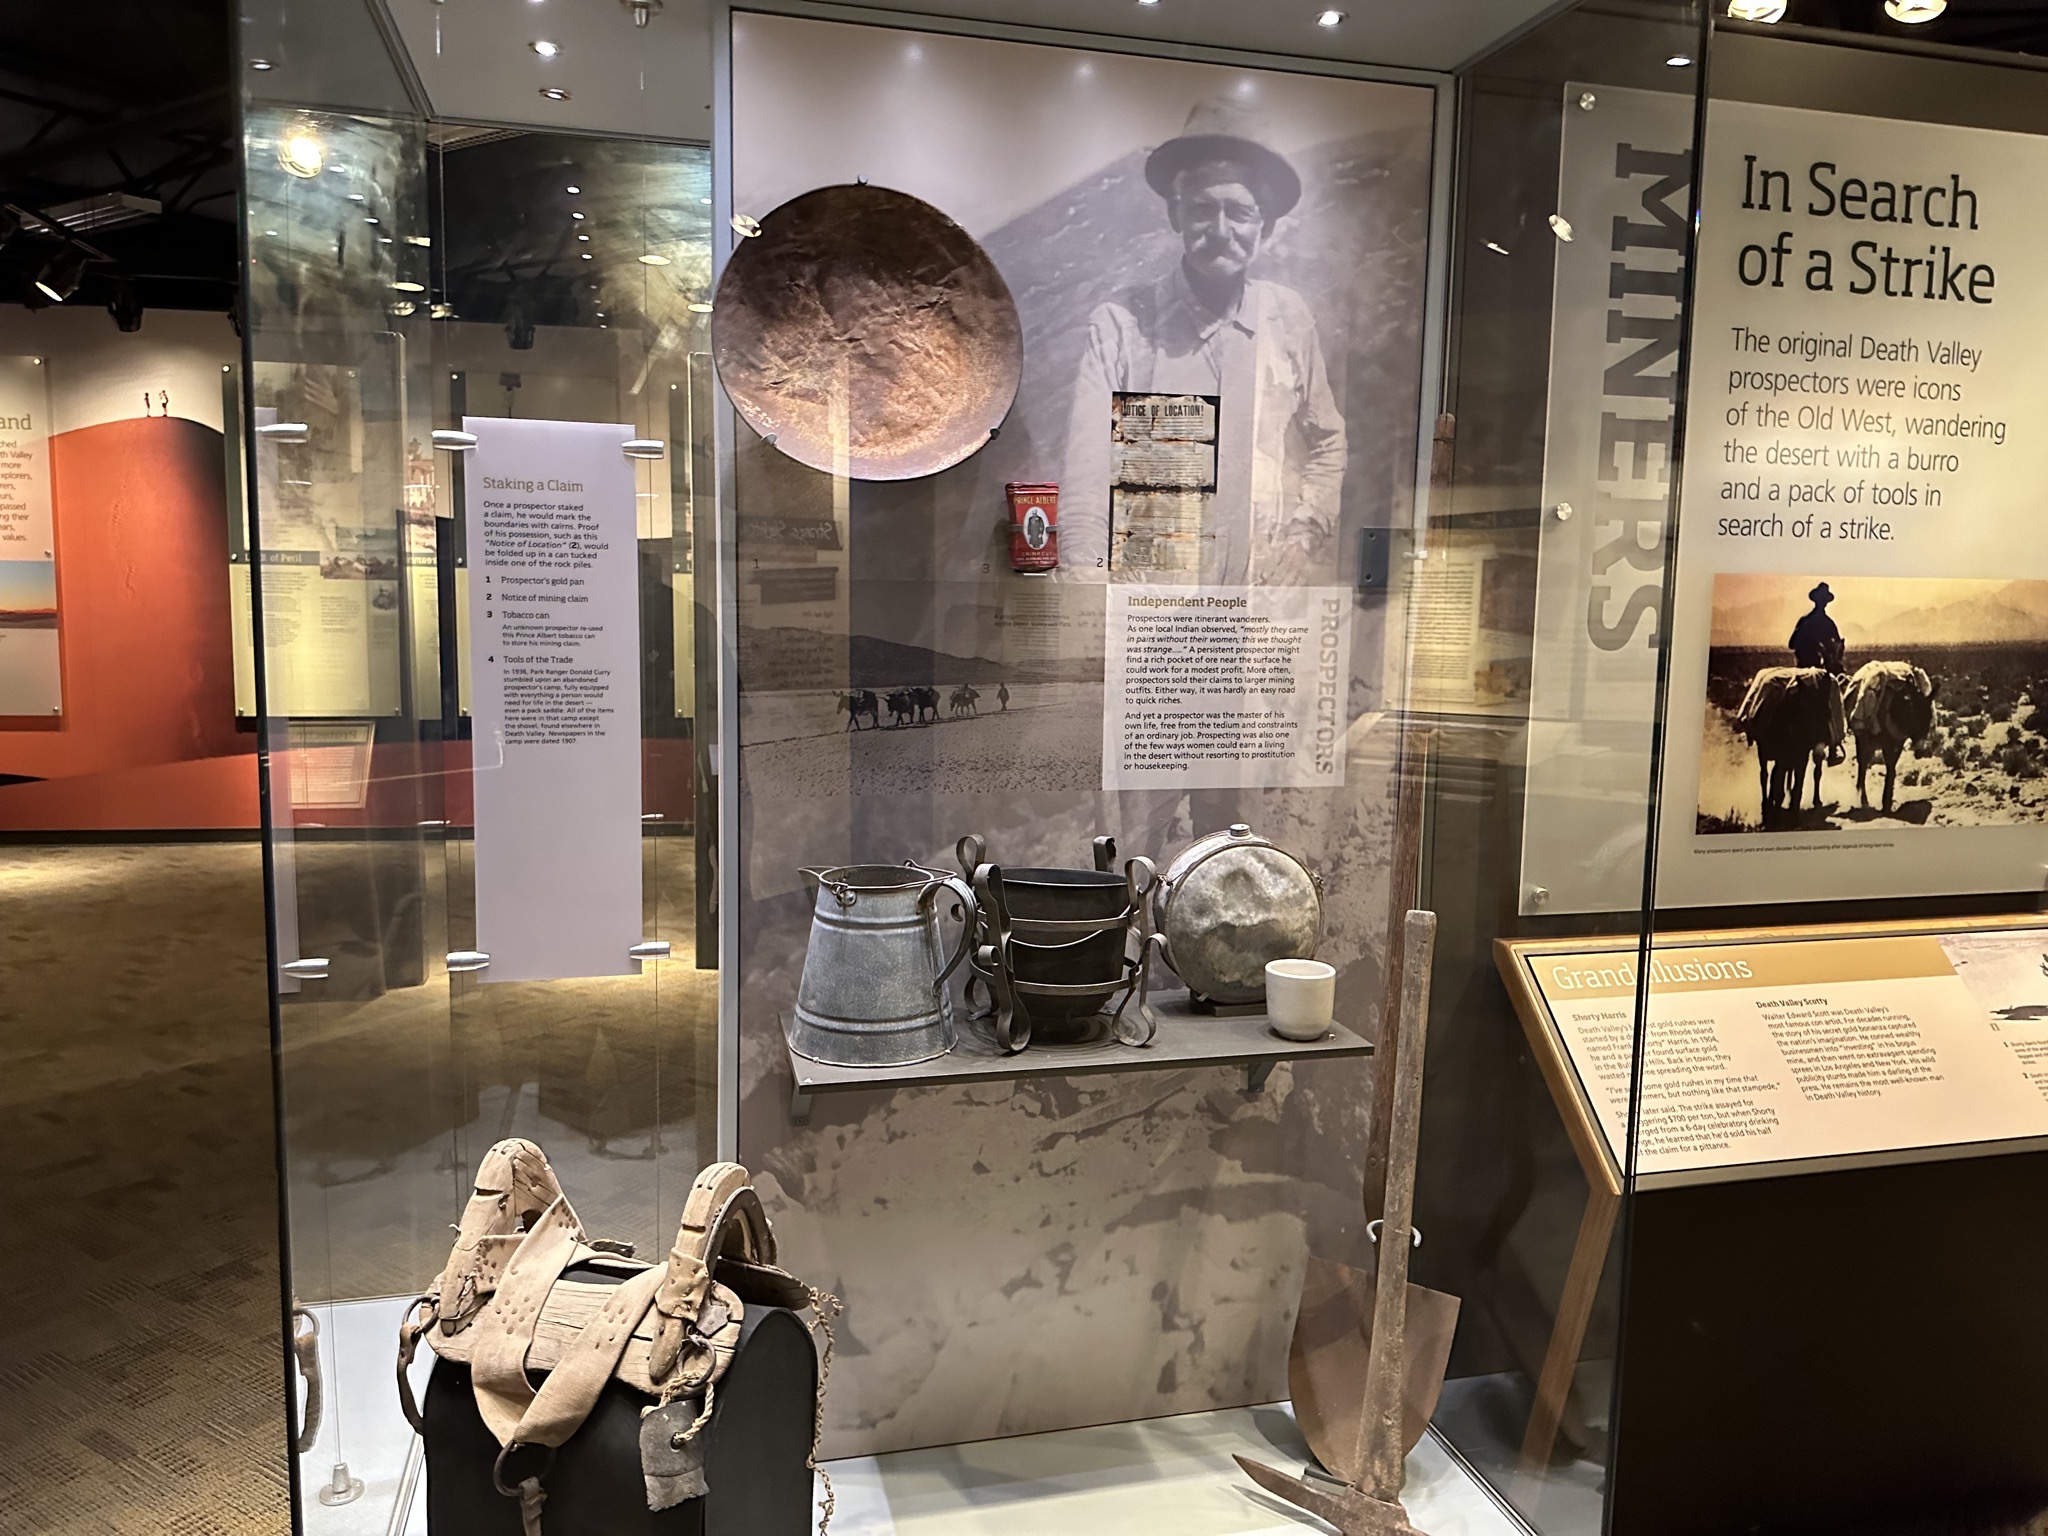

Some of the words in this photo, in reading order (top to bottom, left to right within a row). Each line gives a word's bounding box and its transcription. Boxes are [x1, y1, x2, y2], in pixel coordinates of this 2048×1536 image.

[1741, 154, 1792, 213] In
[1808, 161, 1978, 230] Search
[1738, 231, 1793, 288] of
[1805, 249, 1833, 291] a
[1849, 240, 1995, 304] Strike
[1731, 326, 1770, 353] The
[1778, 331, 1853, 362] original
[1860, 336, 1919, 363] Death
[1927, 340, 1983, 372] Valley
[1728, 370, 1849, 397] prospectors
[1856, 378, 1906, 398] were
[1913, 375, 1962, 402] icons
[1587, 142, 1692, 652] MINERS
[1151, 405, 1160, 417] OF
[1164, 405, 1204, 417] LOCATION!
[1726, 401, 1750, 426] of
[1755, 402, 1790, 428] the
[1798, 405, 1834, 430] Old
[1841, 408, 1896, 437] West,
[1905, 412, 2007, 446] wandering
[10, 451, 33, 461] Valley
[1721, 436, 1758, 464] the
[1766, 439, 1830, 467] desert
[1837, 444, 1880, 469] with
[1887, 452, 1899, 470] a
[1907, 446, 1959, 473] burro
[0, 472, 33, 481] xplorers,
[482, 476, 534, 493] Staking
[536, 481, 545, 491] a
[547, 479, 584, 492] Claim
[1720, 476, 1761, 501] and
[1768, 483, 1780, 501] a
[1788, 478, 1836, 508] pack
[1843, 479, 1865, 504] of
[1871, 481, 1918, 506] tools
[1925, 483, 1941, 507] in
[483, 500, 504, 509] Once
[513, 503, 556, 511] prospector
[557, 504, 584, 512] staked
[1014, 496, 1034, 505] PRINCE
[1036, 496, 1056, 505] ALBERT
[0, 502, 26, 512] passed
[12, 513, 29, 521] their
[490, 510, 514, 519] claim,
[516, 511, 527, 519] he
[528, 512, 554, 520] would
[484, 520, 529, 530] boundaries
[577, 523, 599, 531] Proof
[1717, 512, 1783, 537] search
[1791, 513, 1814, 538] of
[1820, 521, 1832, 539] a
[1838, 515, 1894, 541] strike.
[2, 533, 27, 541] values.
[484, 529, 493, 537] of
[508, 531, 552, 541] possession,
[553, 532, 572, 540] such
[583, 533, 598, 541] this
[517, 540, 527, 548] of
[568, 541, 582, 550] (2),
[485, 549, 496, 557] be
[497, 549, 524, 557] folded
[525, 551, 537, 559] up
[528, 559, 537, 567] of
[538, 560, 553, 568] the
[554, 560, 571, 568] rock
[573, 561, 592, 569] piles.
[754, 559, 760, 569] 1
[1097, 558, 1103, 567] 2
[982, 564, 990, 573] 3
[501, 576, 550, 586] Prospector's
[551, 577, 568, 587] gold
[569, 579, 585, 587] pan
[486, 593, 492, 601] 2
[501, 593, 527, 602] Notice
[528, 594, 537, 602] of
[538, 595, 566, 604] mining
[567, 595, 589, 603] claim
[1128, 596, 1205, 609] Independent
[1206, 597, 1247, 609] People
[486, 610, 493, 618] 3
[502, 611, 534, 619] Tobacco
[1127, 614, 1172, 624] Prospectors
[1194, 614, 1228, 623] itinerant
[1126, 625, 1137, 633] As
[1155, 625, 1174, 633] local
[1175, 625, 1200, 633] Indian
[1201, 625, 1238, 634] observed,
[1270, 626, 1287, 635] they
[488, 655, 494, 663] 4
[503, 655, 525, 663] Tools
[525, 655, 534, 664] of
[535, 656, 549, 664] the
[550, 656, 574, 664] Trade
[1316, 598, 1341, 775] PROSPECTORS
[1552, 963, 1637, 990] Grand
[1646, 958, 1753, 984] llusions
[1755, 1000, 1780, 1009] Death
[1778, 999, 1804, 1007] Valley
[1803, 998, 1828, 1006] Scotty
[1572, 1013, 1600, 1022] Shorty
[1600, 1011, 1627, 1020] Harris
[1644, 1148, 1658, 1156] the
[1659, 1146, 1680, 1155] claim
[1699, 1142, 1729, 1152] pittance.
